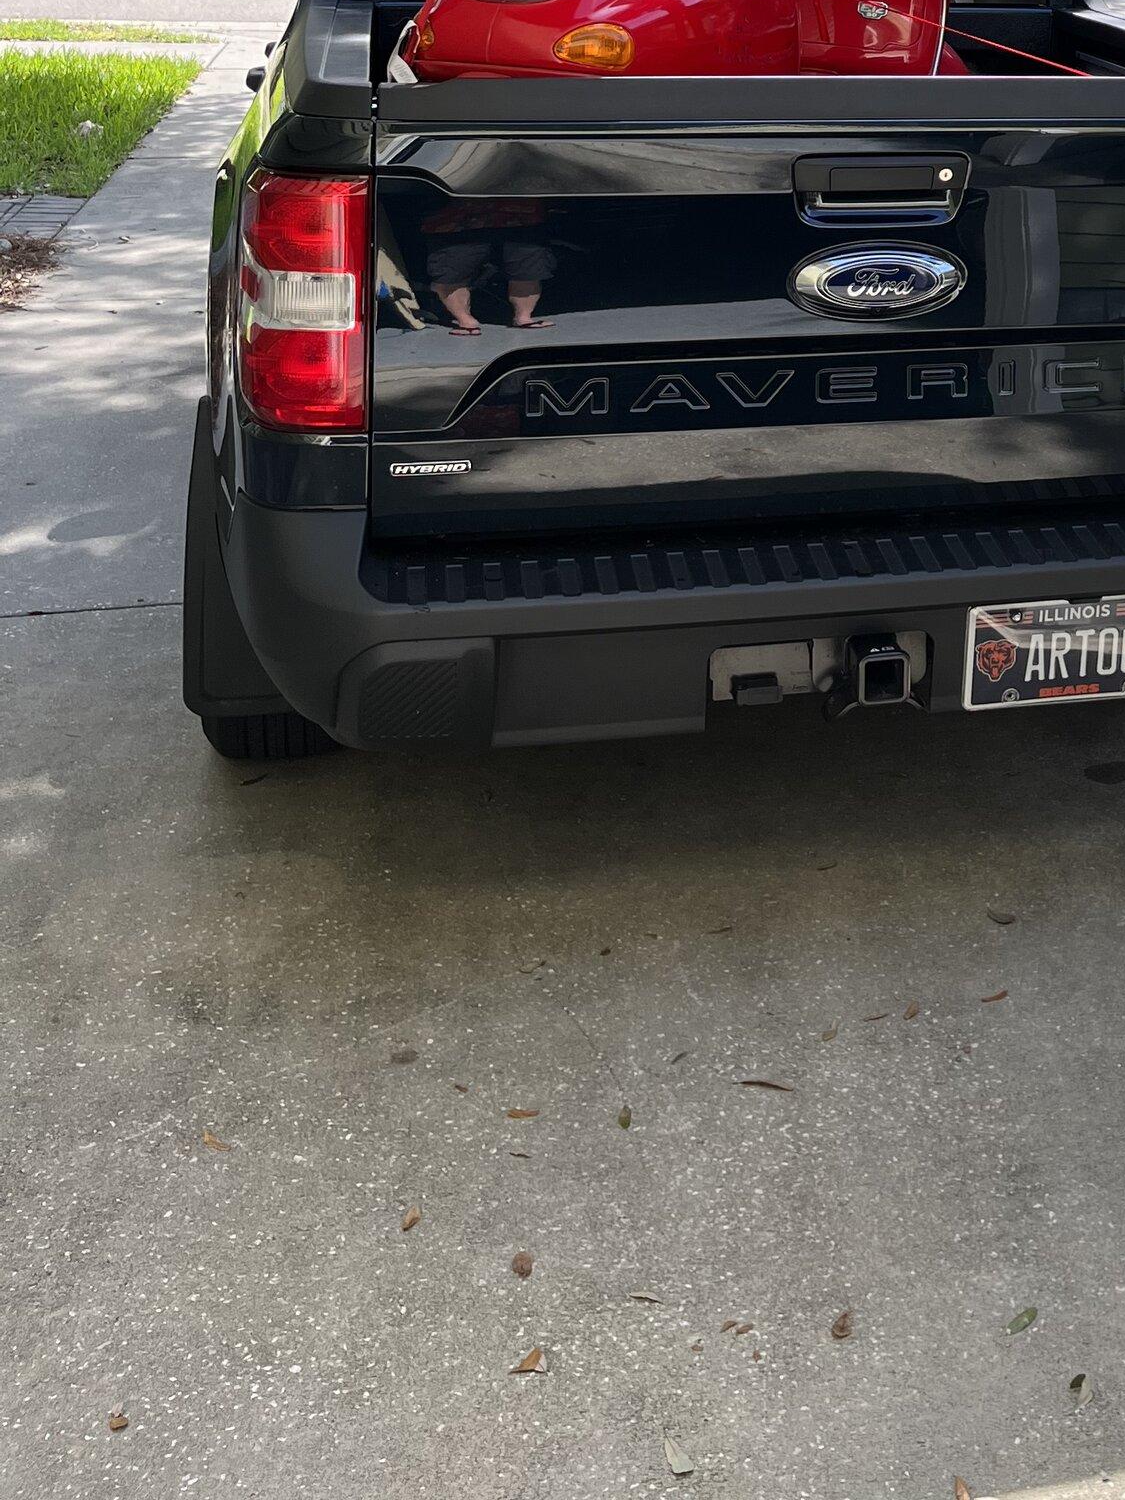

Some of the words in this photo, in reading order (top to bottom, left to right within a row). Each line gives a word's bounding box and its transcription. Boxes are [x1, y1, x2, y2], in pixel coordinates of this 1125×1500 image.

[847, 267, 916, 297] Ford
[394, 463, 467, 474] HYBRID
[1038, 603, 1112, 623] ILLINOIS
[1039, 683, 1100, 698] BEARS
